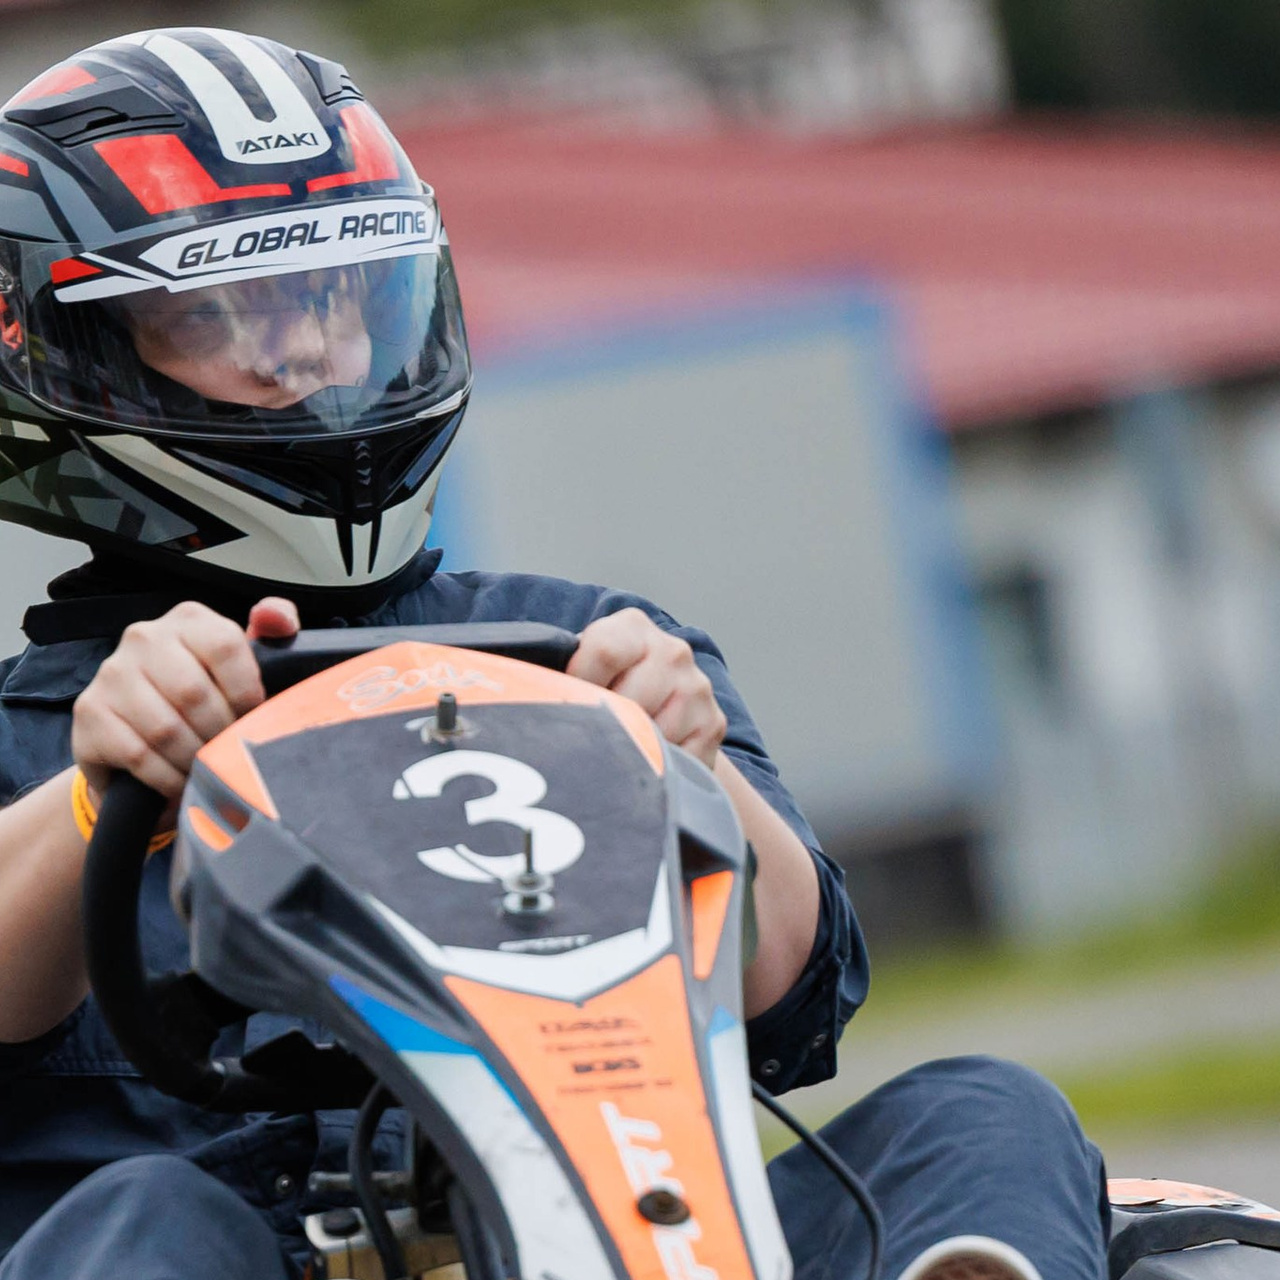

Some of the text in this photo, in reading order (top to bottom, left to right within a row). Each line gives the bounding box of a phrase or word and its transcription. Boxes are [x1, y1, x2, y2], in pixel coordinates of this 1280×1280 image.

[236, 132, 319, 154] ATAKI
[177, 211, 426, 269] GLOBAL RACING
[392, 750, 585, 884] 3
